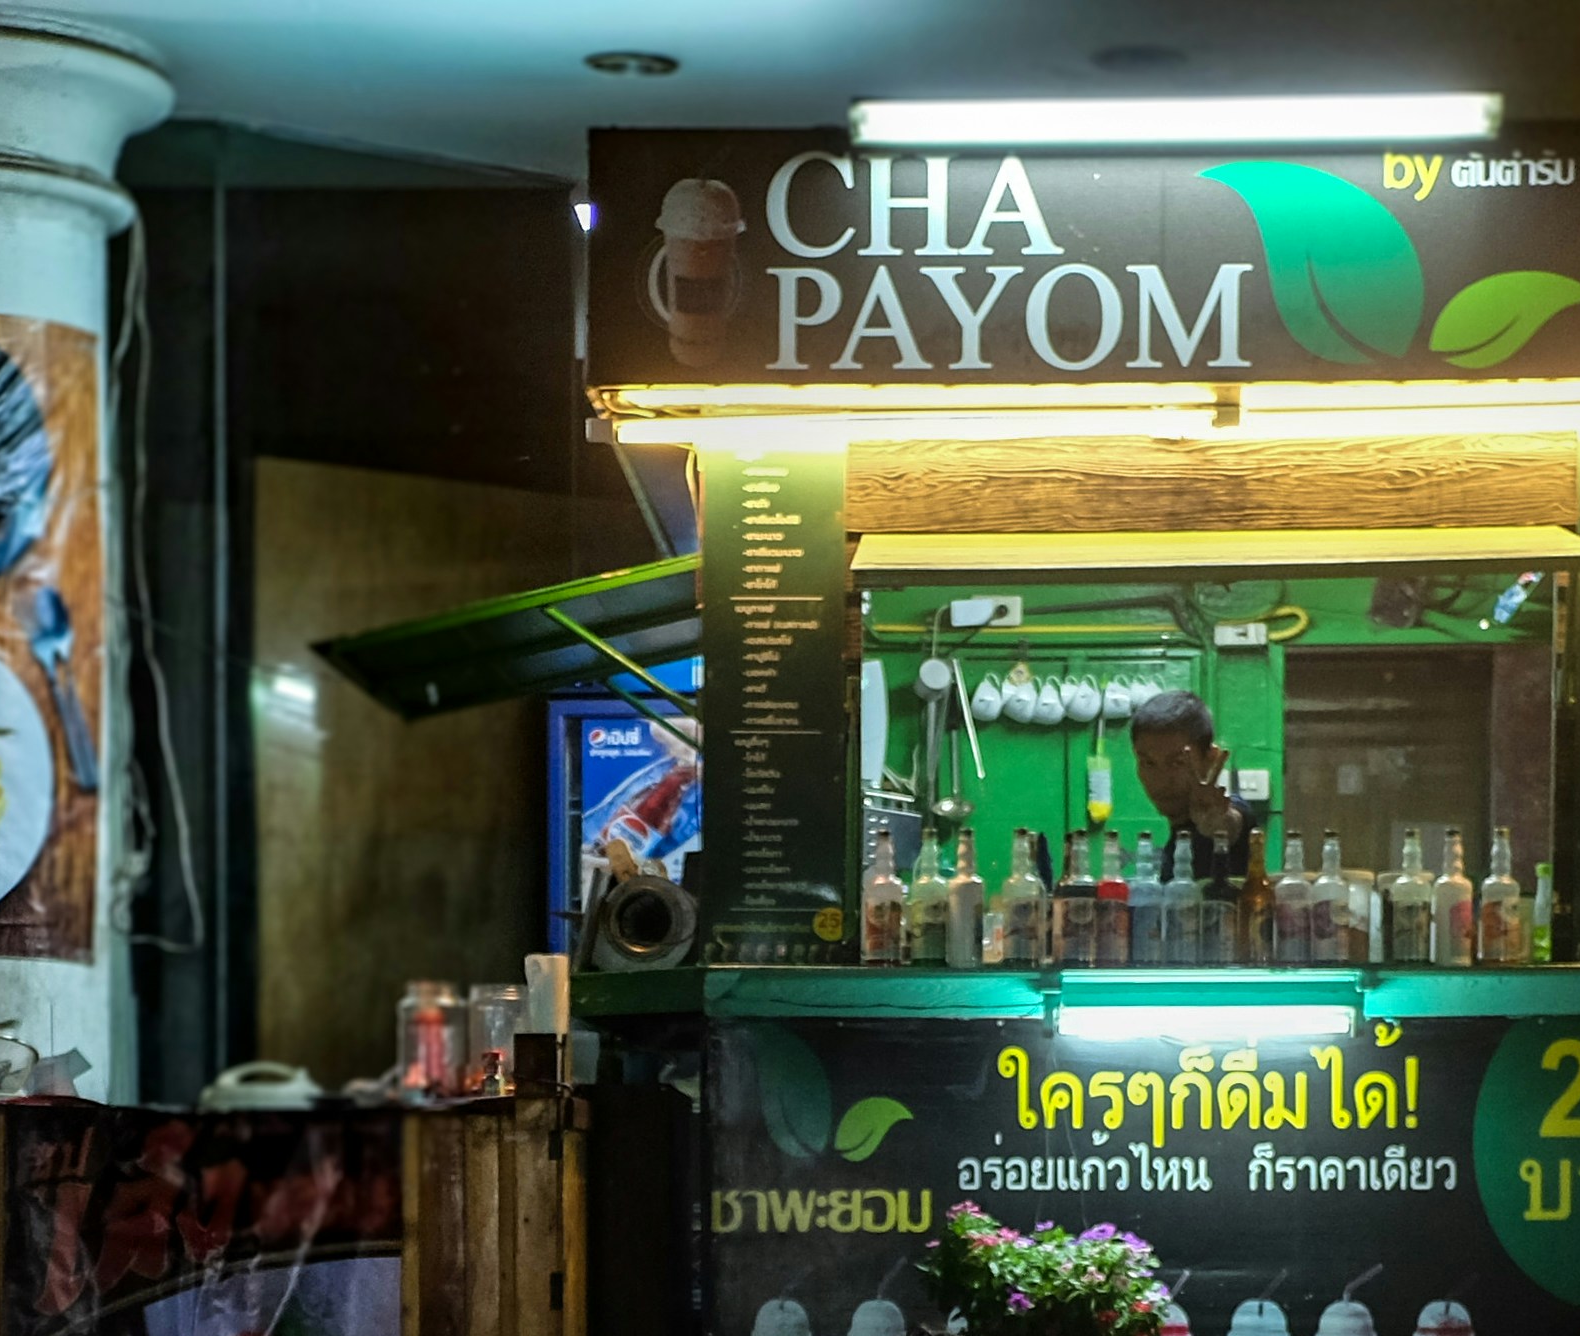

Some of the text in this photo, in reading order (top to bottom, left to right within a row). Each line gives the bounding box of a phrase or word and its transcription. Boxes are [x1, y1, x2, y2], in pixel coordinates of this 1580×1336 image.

[766, 152, 1066, 258] CHA
[1382, 151, 1442, 201] by
[766, 262, 1253, 372] PAYOM
[817, 912, 841, 929] 25
[997, 1023, 1420, 1149] ใครๆก็ดื่มได้!
[956, 1133, 1458, 1194] อร่อยแก้วไหน ก็ราคาเดียว
[711, 1185, 932, 1235] ชาพะยอม
